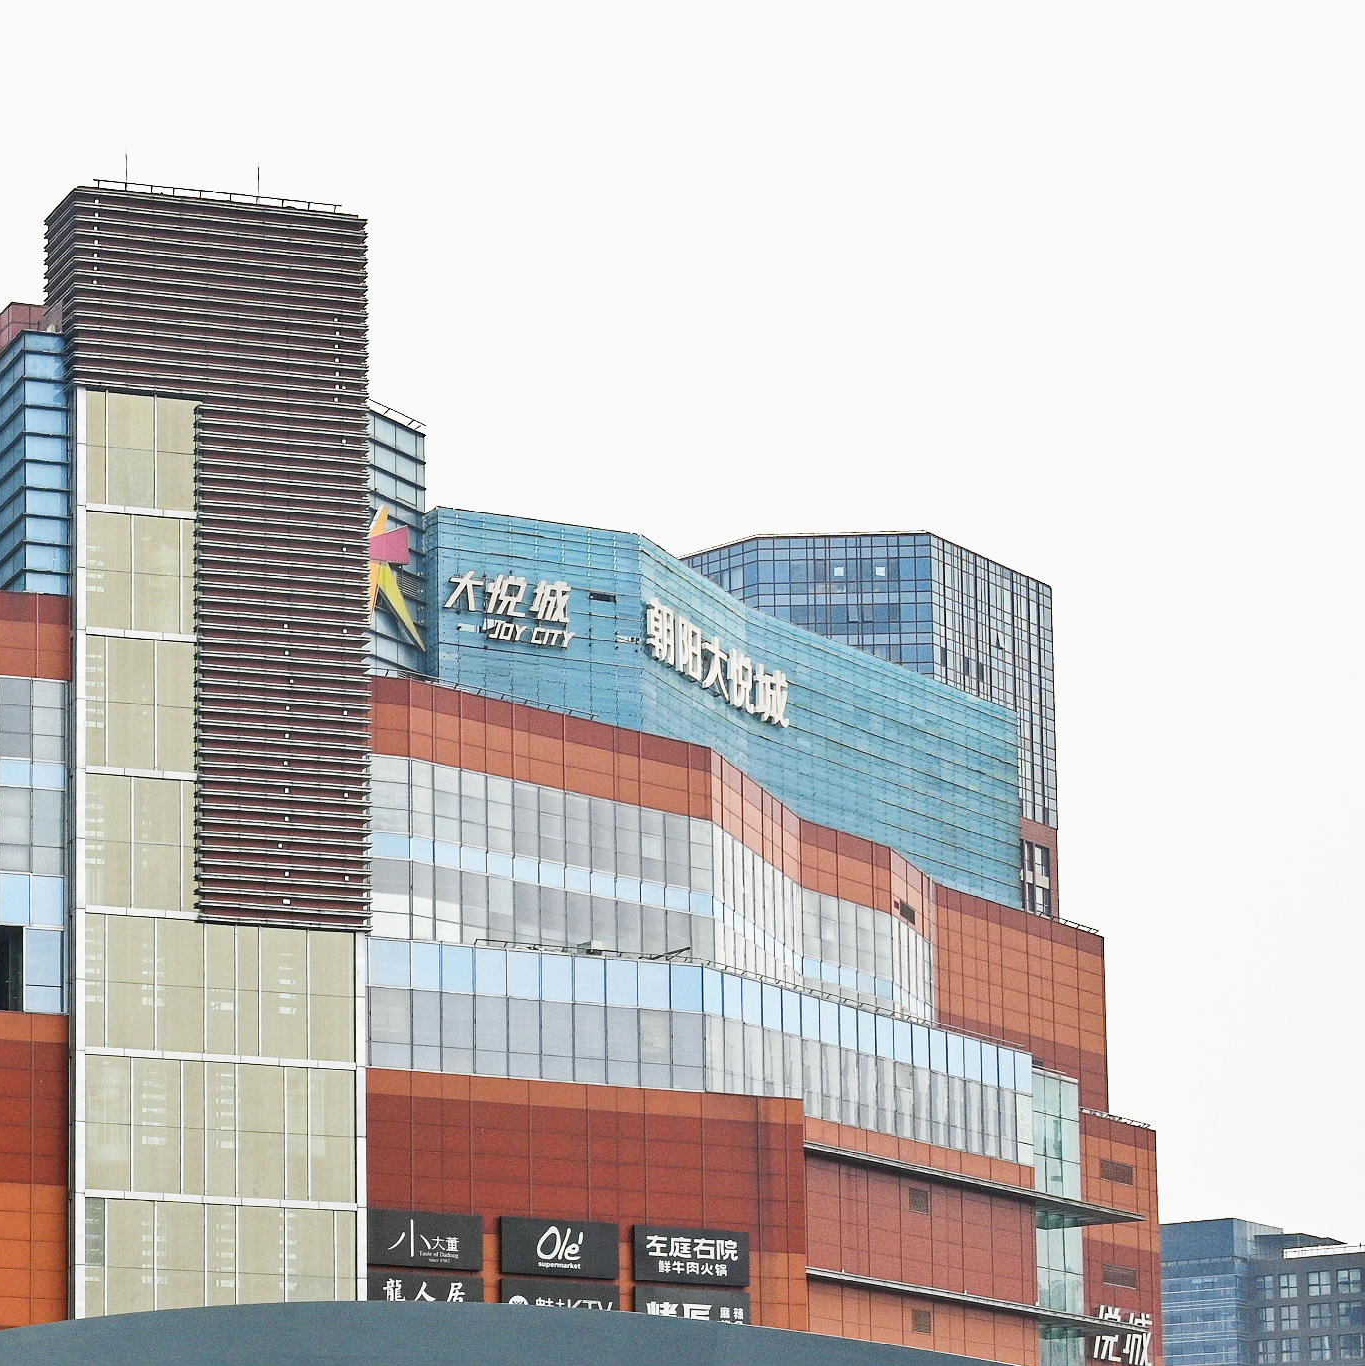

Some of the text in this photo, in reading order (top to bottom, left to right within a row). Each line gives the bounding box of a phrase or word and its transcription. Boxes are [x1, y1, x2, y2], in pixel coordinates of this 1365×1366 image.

[444, 571, 572, 624] 大悦城
[488, 619, 575, 648] JOY CITY
[647, 598, 790, 728] 朝阳大悦城
[646, 1235, 739, 1261] 左庭右院
[537, 1261, 581, 1270] supermarket
[658, 1260, 728, 1277] 鲜牛肉火锅
